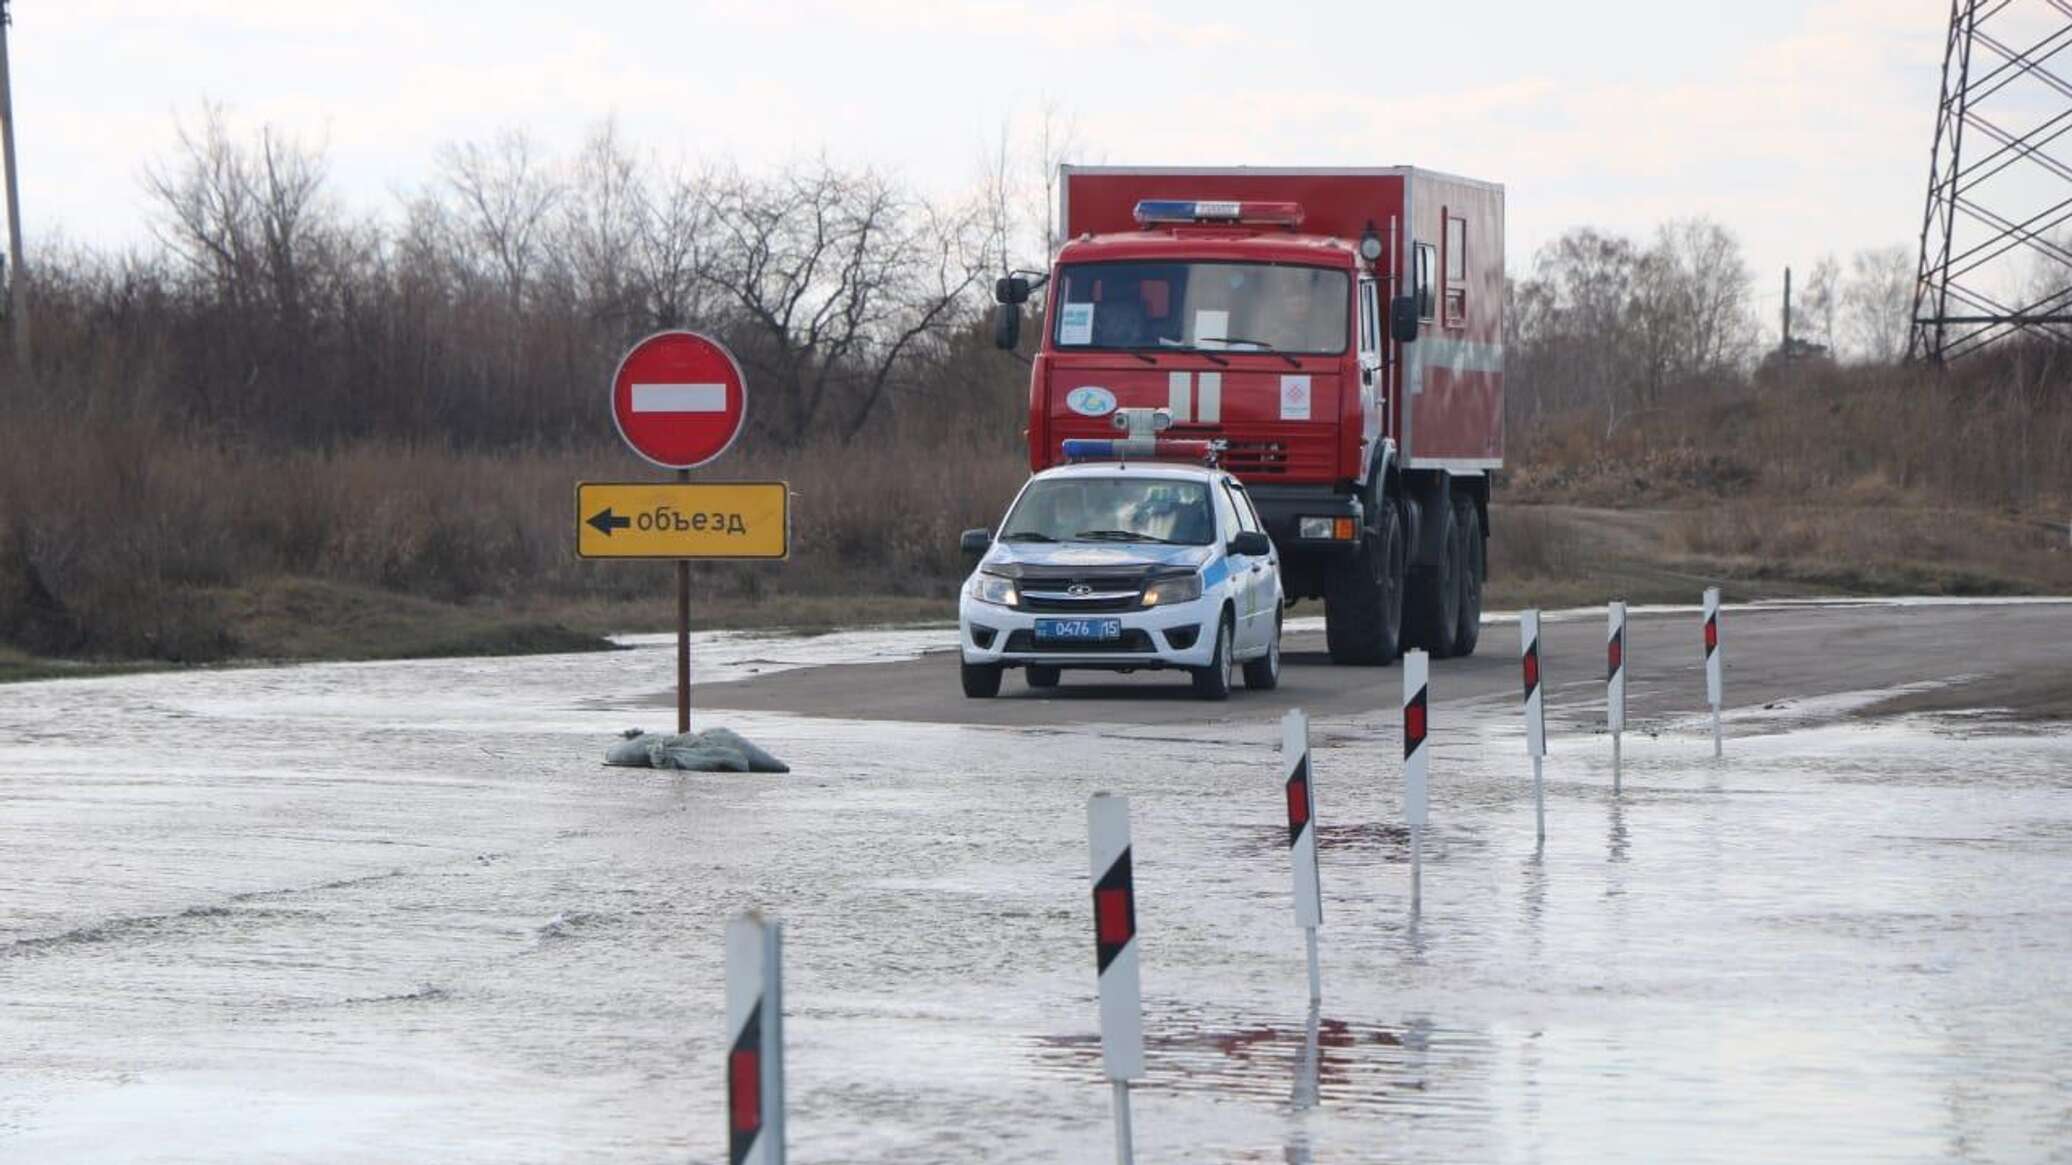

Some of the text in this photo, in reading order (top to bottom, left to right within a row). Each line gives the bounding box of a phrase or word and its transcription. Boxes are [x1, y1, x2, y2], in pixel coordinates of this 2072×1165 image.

[637, 506, 746, 534] объезд
[1055, 621, 1089, 636] 0476
[1103, 620, 1118, 635] 15
